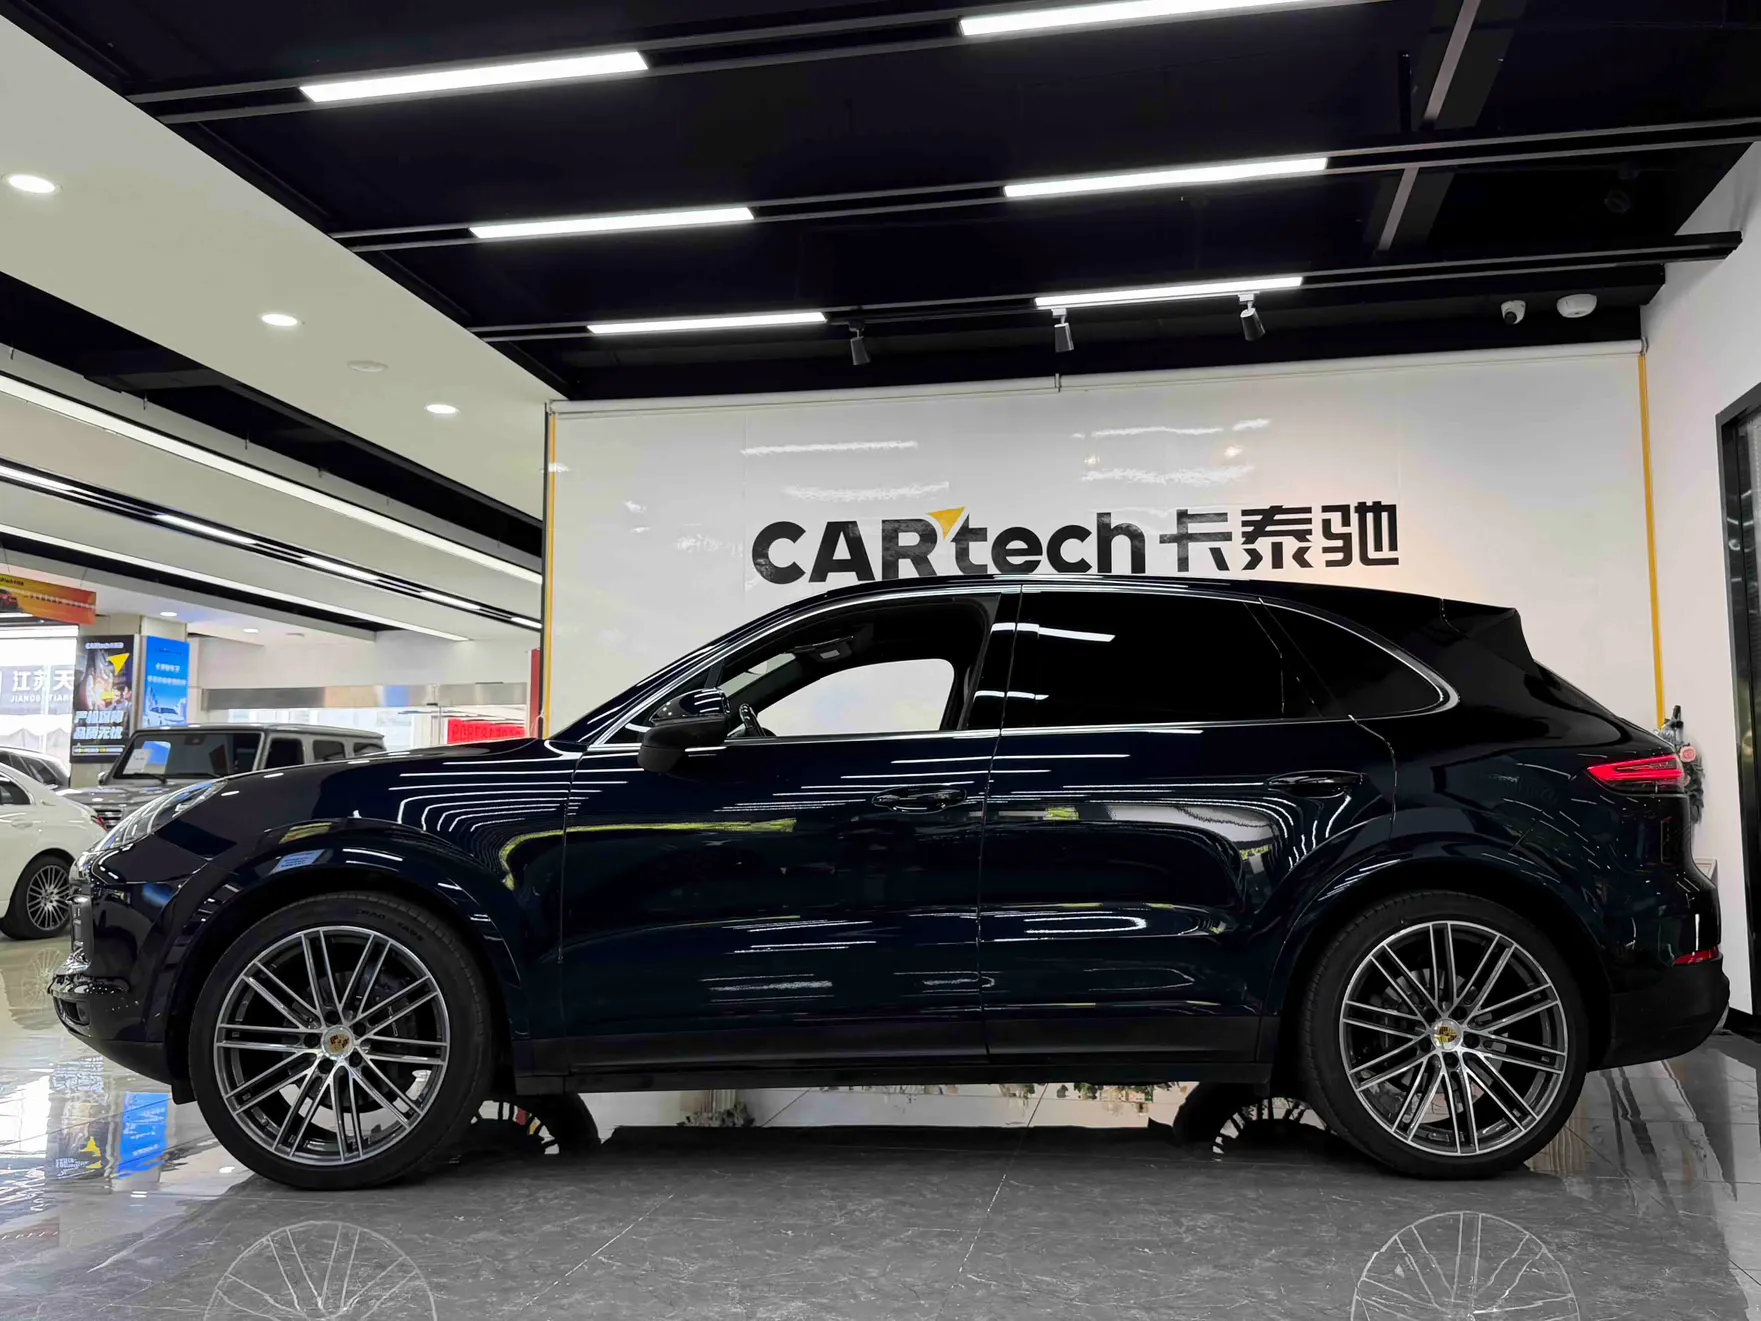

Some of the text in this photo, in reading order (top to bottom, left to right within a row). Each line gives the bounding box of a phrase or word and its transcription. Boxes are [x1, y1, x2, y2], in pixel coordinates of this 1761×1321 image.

[752, 501, 1399, 585] CARtech 卡泰驰
